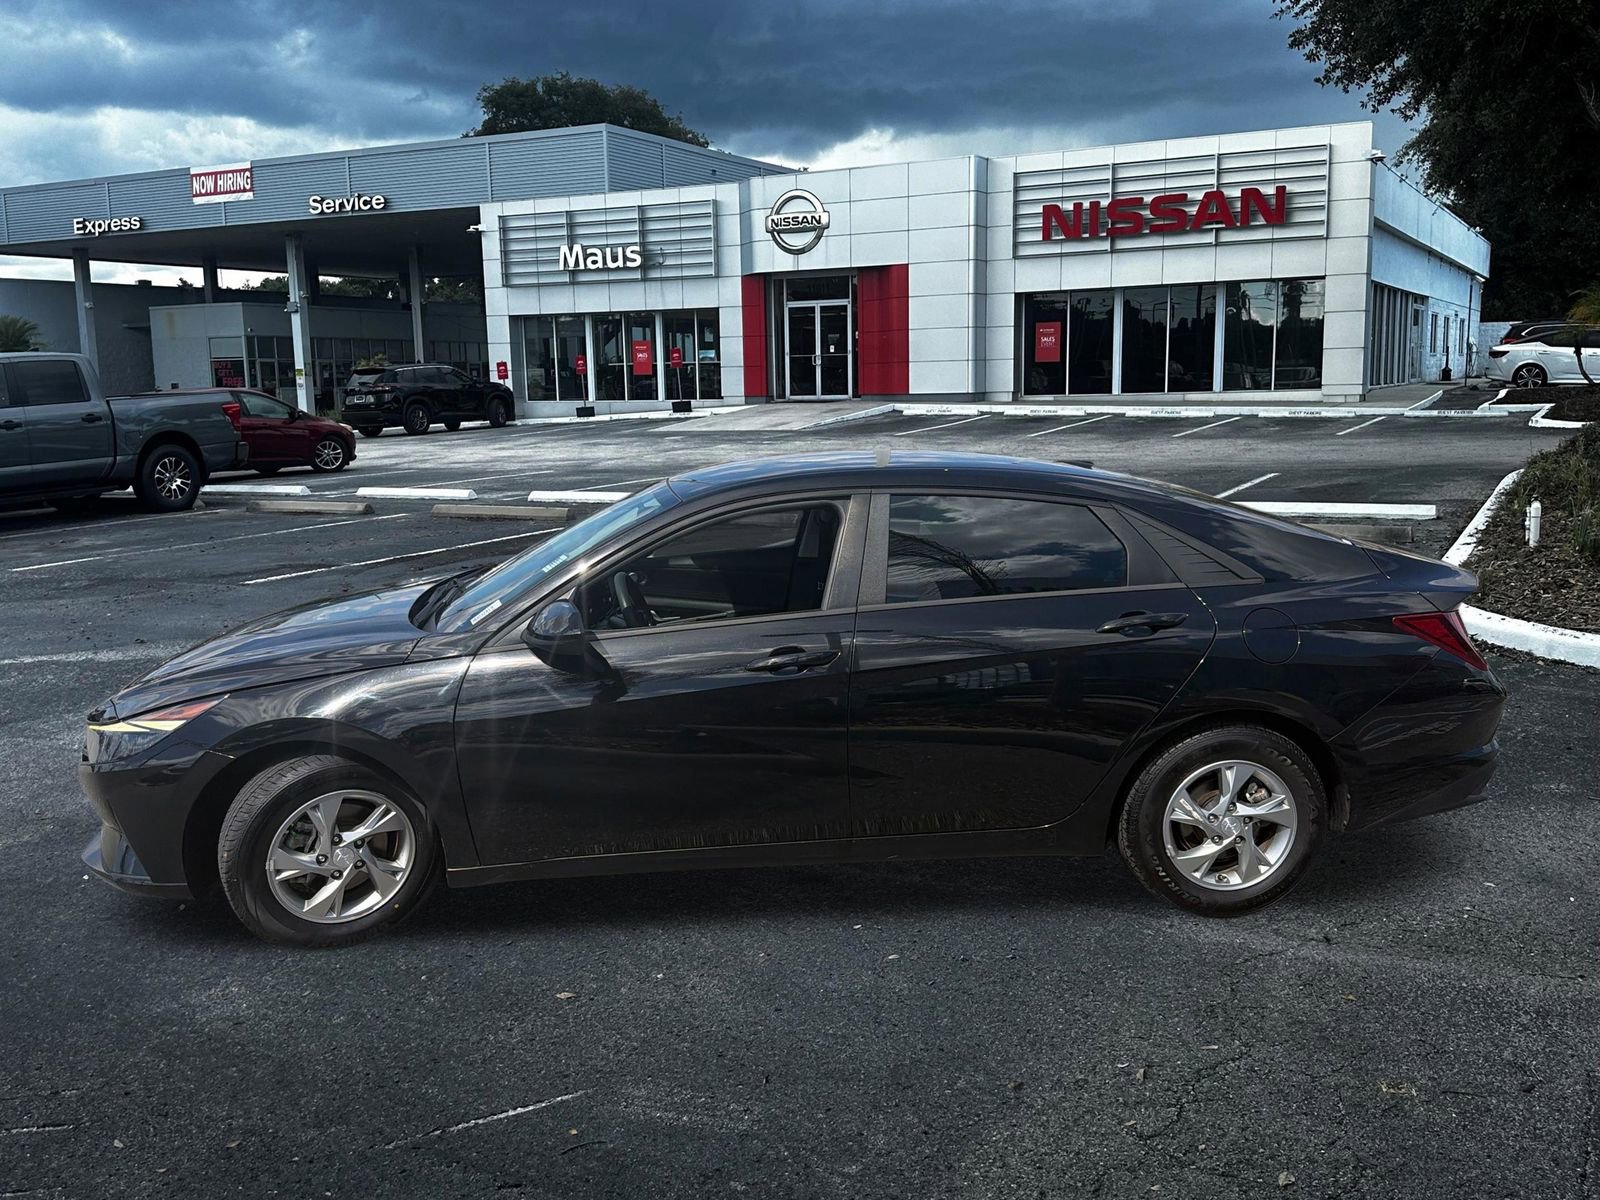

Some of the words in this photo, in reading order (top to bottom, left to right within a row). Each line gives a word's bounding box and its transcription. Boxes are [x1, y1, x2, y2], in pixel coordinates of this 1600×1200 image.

[192, 174, 215, 195] NOW
[217, 171, 251, 192] HIRING
[309, 192, 385, 215] Service
[1041, 185, 1287, 241] NISSAN
[73, 216, 141, 237] Express
[770, 214, 822, 228] NISSAN
[559, 243, 642, 271] Maus
[222, 376, 244, 387] FREE
